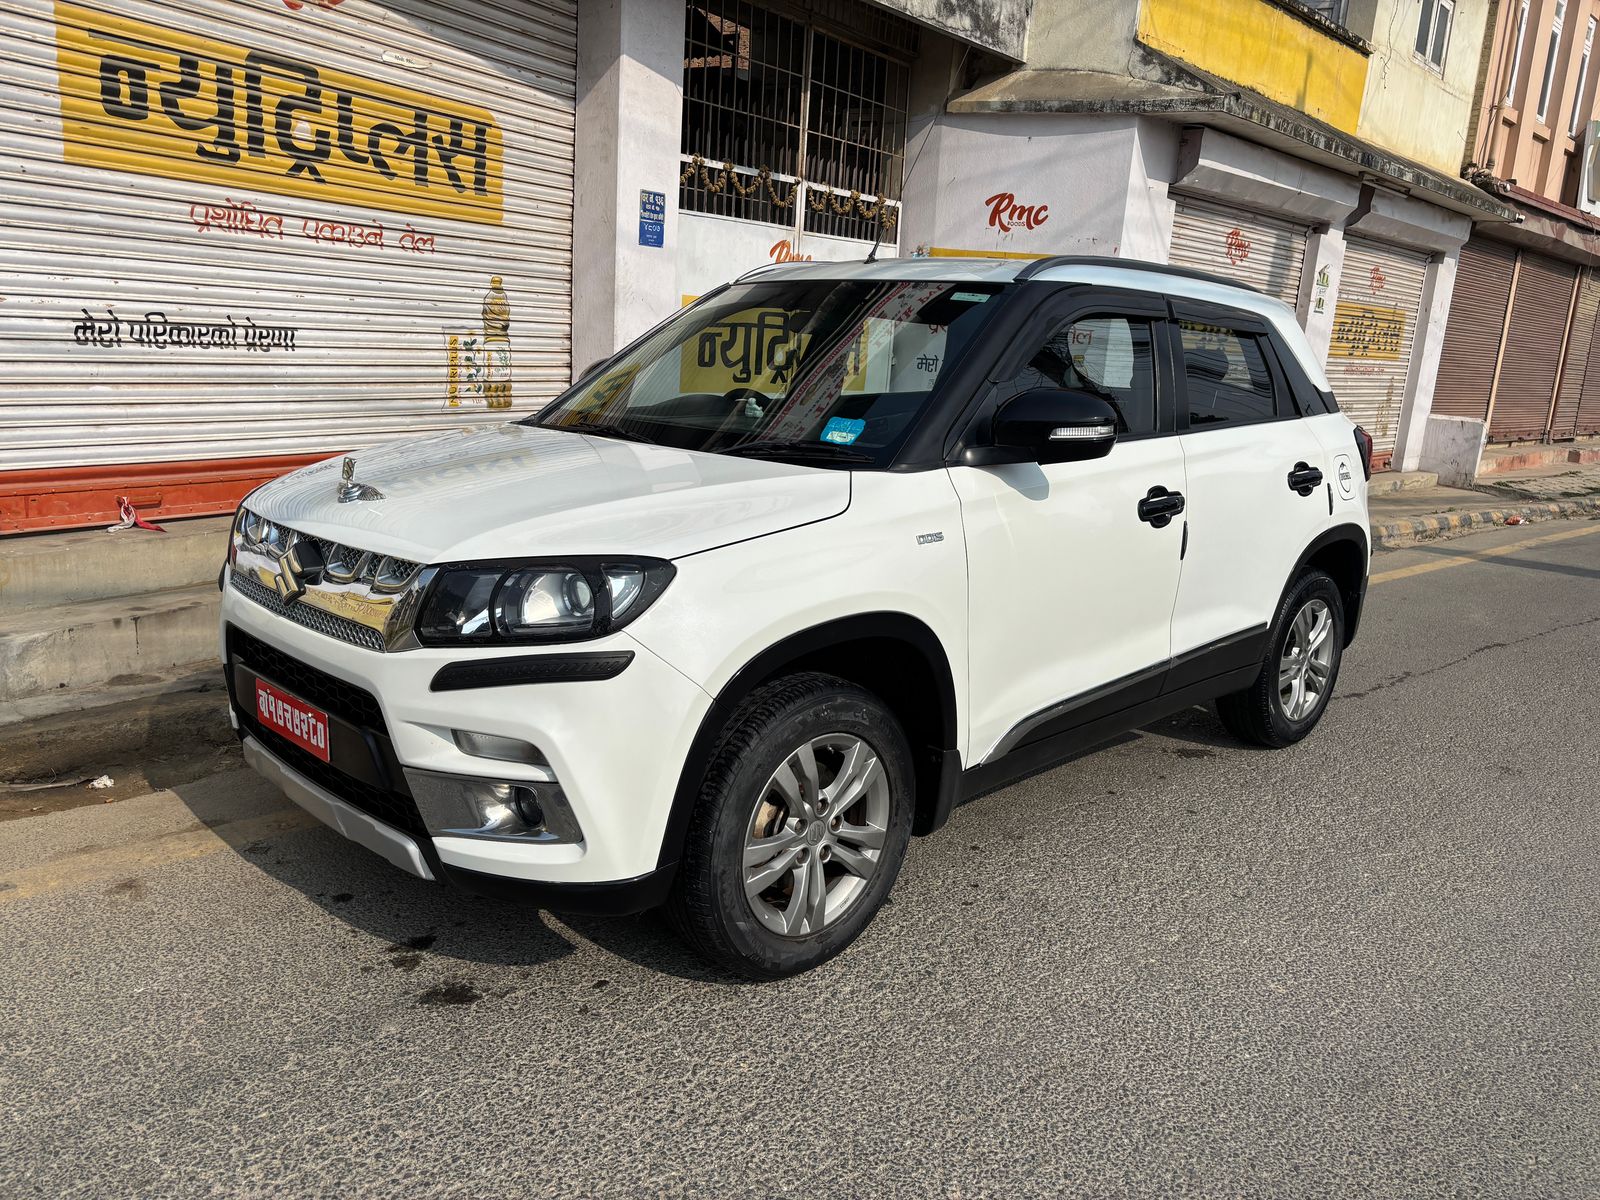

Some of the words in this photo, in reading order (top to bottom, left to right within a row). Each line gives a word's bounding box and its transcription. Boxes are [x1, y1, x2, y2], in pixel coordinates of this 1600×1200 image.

[190, 196, 284, 240] प्रशोधित
[303, 217, 384, 250] पकाउने
[399, 222, 436, 255] तेल
[985, 192, 1049, 233] Rmc
[72, 308, 123, 348] मेरो
[127, 311, 238, 350] परिकारको
[242, 315, 299, 352] प्रेरणा
